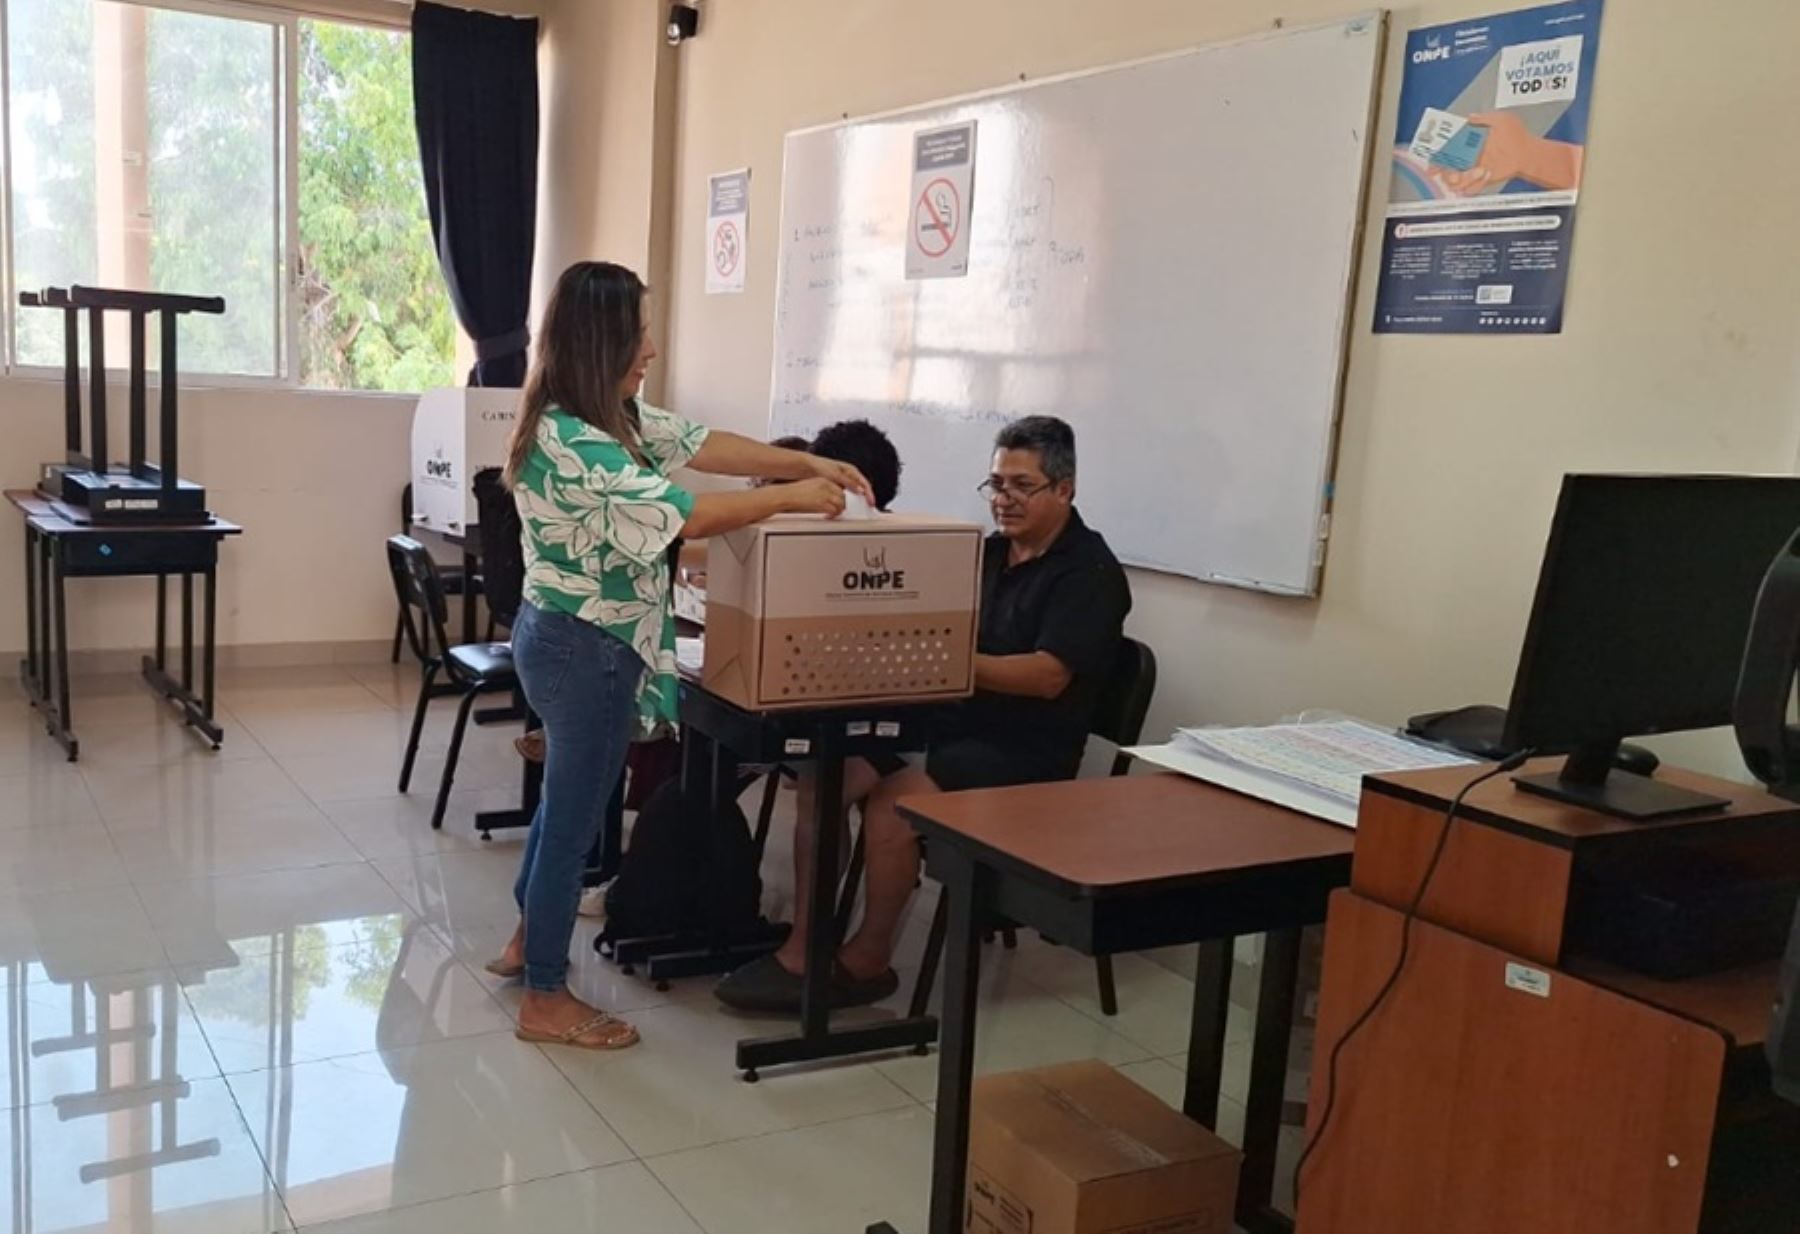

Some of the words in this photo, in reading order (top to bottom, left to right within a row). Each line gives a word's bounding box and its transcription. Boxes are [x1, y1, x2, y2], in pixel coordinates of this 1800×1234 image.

[1413, 46, 1450, 63] ONPE
[1505, 61, 1574, 80] VOTAMOS
[427, 459, 452, 478] ONPE
[843, 570, 904, 590] ONPE
